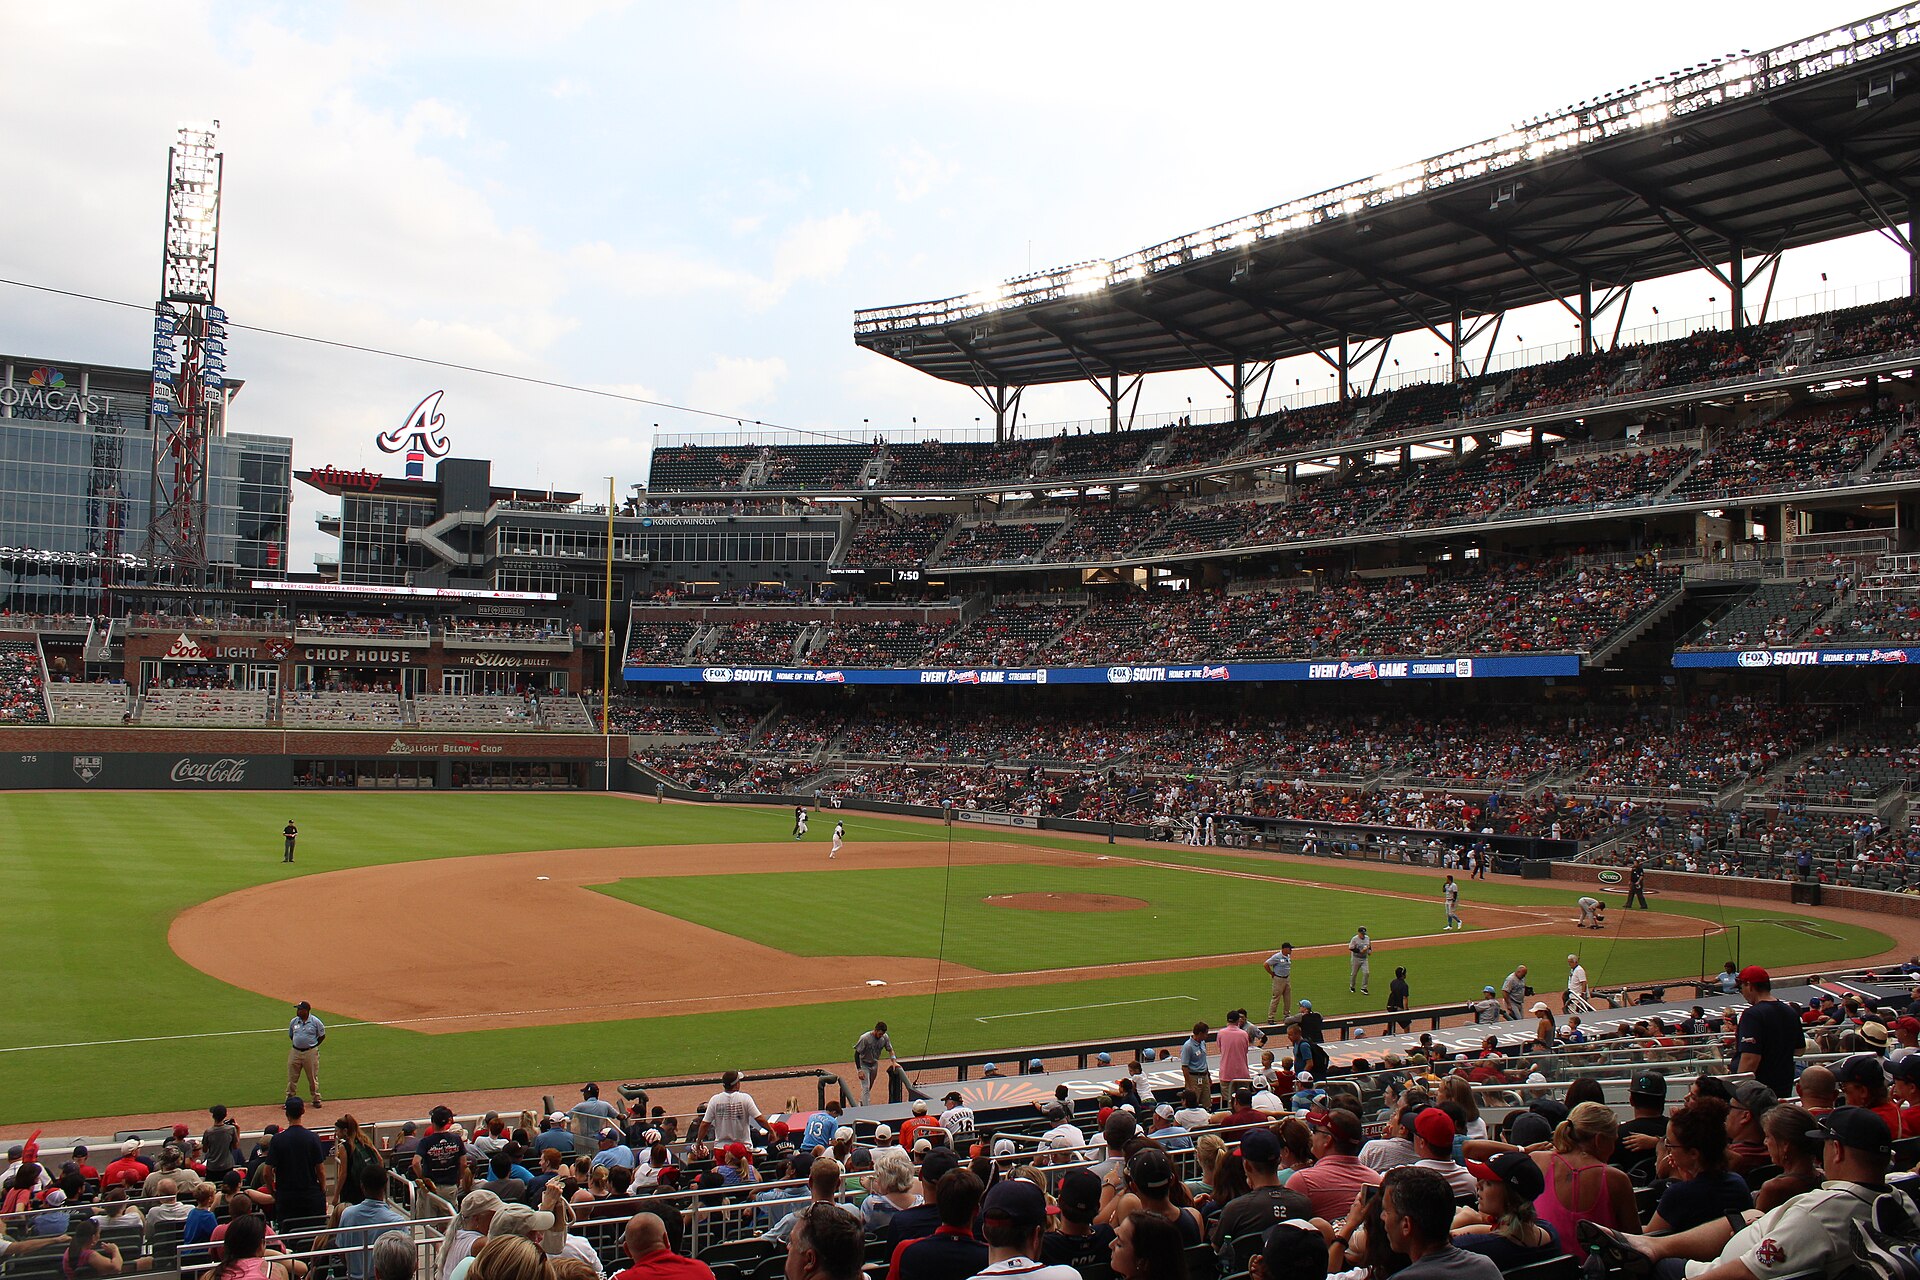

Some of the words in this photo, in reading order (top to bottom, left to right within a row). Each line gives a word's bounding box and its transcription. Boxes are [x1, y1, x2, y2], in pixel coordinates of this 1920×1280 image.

[210, 309, 223, 319] 1997
[158, 321, 173, 329] 1998
[157, 340, 173, 348] 2000
[208, 342, 222, 351] 2001
[156, 355, 172, 363] 2002
[207, 358, 222, 368] 2003
[206, 374, 221, 384] 2005
[155, 387, 170, 397] 2010
[205, 390, 220, 400] 2012
[153, 404, 169, 413] 2013
[652, 518, 681, 526] KONICA
[683, 518, 717, 526] MINOLTA
[898, 571, 920, 580] 7:50
[168, 640, 214, 659] Coors
[215, 647, 257, 659] LIGHT
[305, 649, 350, 661] CHOP
[356, 650, 411, 663] HOUSE
[460, 656, 474, 664] THE
[475, 651, 522, 667] Silver
[1745, 652, 1764, 661] FOX
[1823, 654, 1845, 662] HOME
[1845, 654, 1855, 662] OF
[1856, 653, 1870, 661] THE
[709, 669, 726, 677] FOX
[1112, 668, 1127, 677] FOX
[1192, 670, 1202, 678] THE
[1308, 664, 1339, 678] EVERY
[1379, 662, 1408, 677] GAME
[1412, 663, 1445, 674] STREAMING
[1445, 663, 1456, 674] ON
[776, 672, 795, 680] HOME
[804, 673, 815, 681] THE
[921, 671, 947, 683] EVERY
[980, 671, 1005, 683] GAME
[21, 755, 37, 763] 375
[75, 757, 100, 765] MLB
[170, 757, 249, 783] Coca-Cola
[1693, 1023, 1705, 1034] 10
[809, 1120, 823, 1137] 13
[1273, 1205, 1287, 1218] 62
